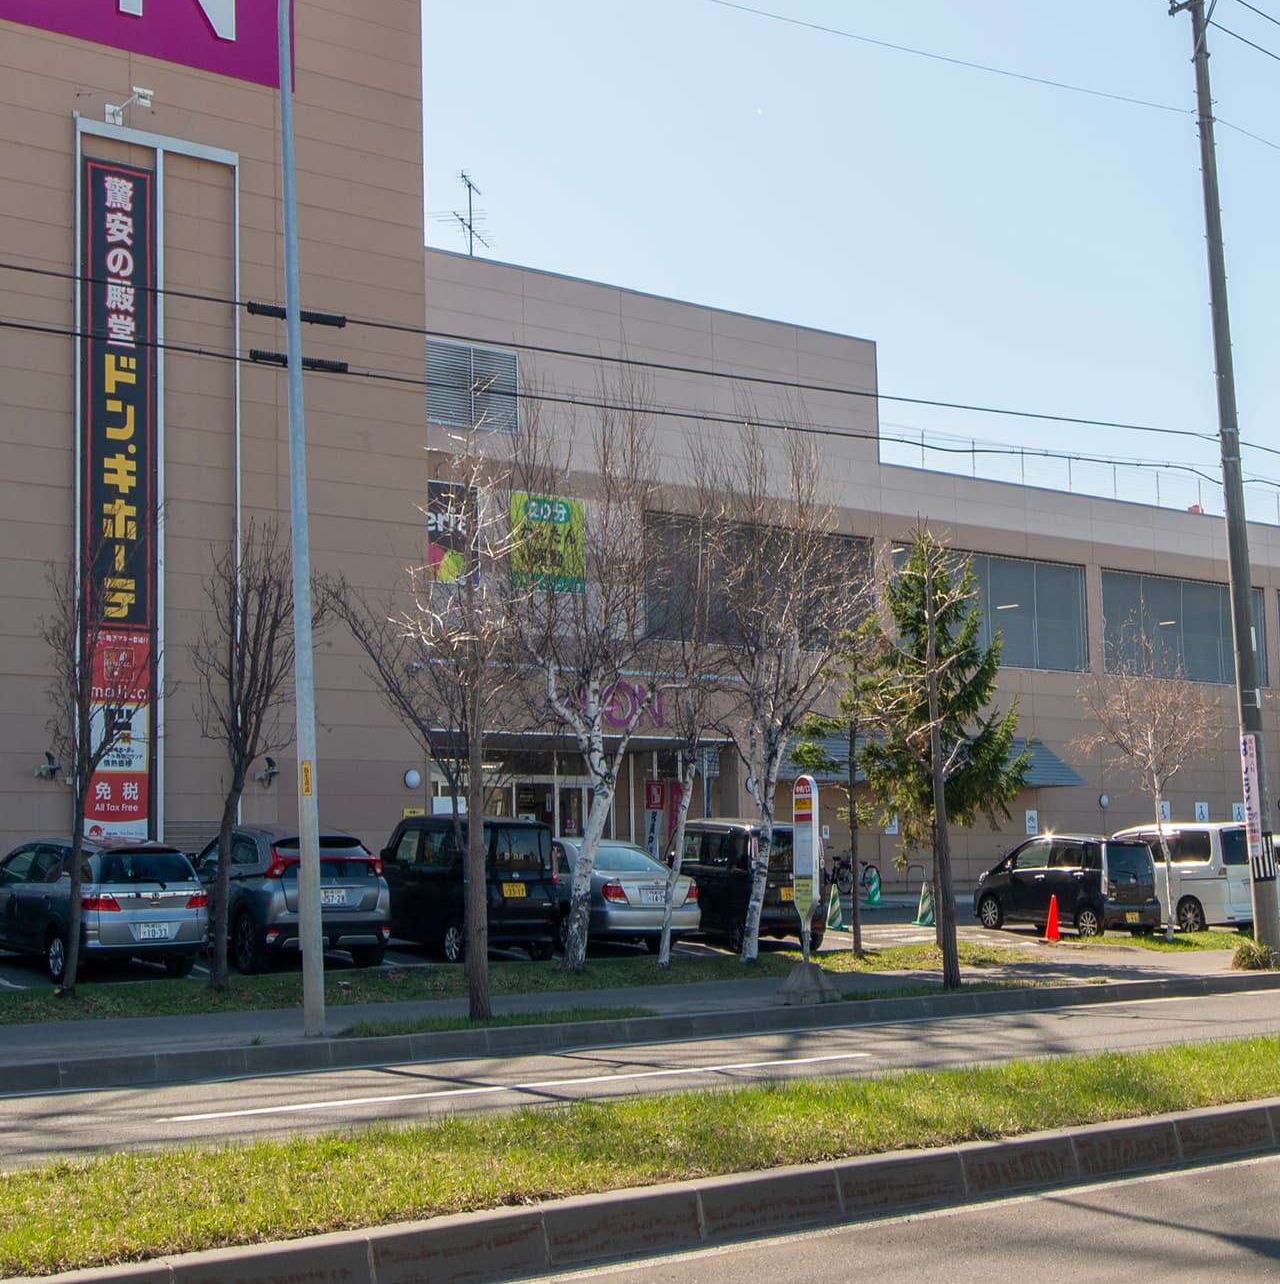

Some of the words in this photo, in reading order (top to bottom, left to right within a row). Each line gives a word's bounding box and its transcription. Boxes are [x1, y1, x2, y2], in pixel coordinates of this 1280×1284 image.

[104, 175, 137, 349] 驚安の殿堂
[103, 353, 137, 618] ドン・キホーテ
[95, 804, 104, 812] All
[107, 804, 119, 812] Tax
[122, 804, 138, 812] Free
